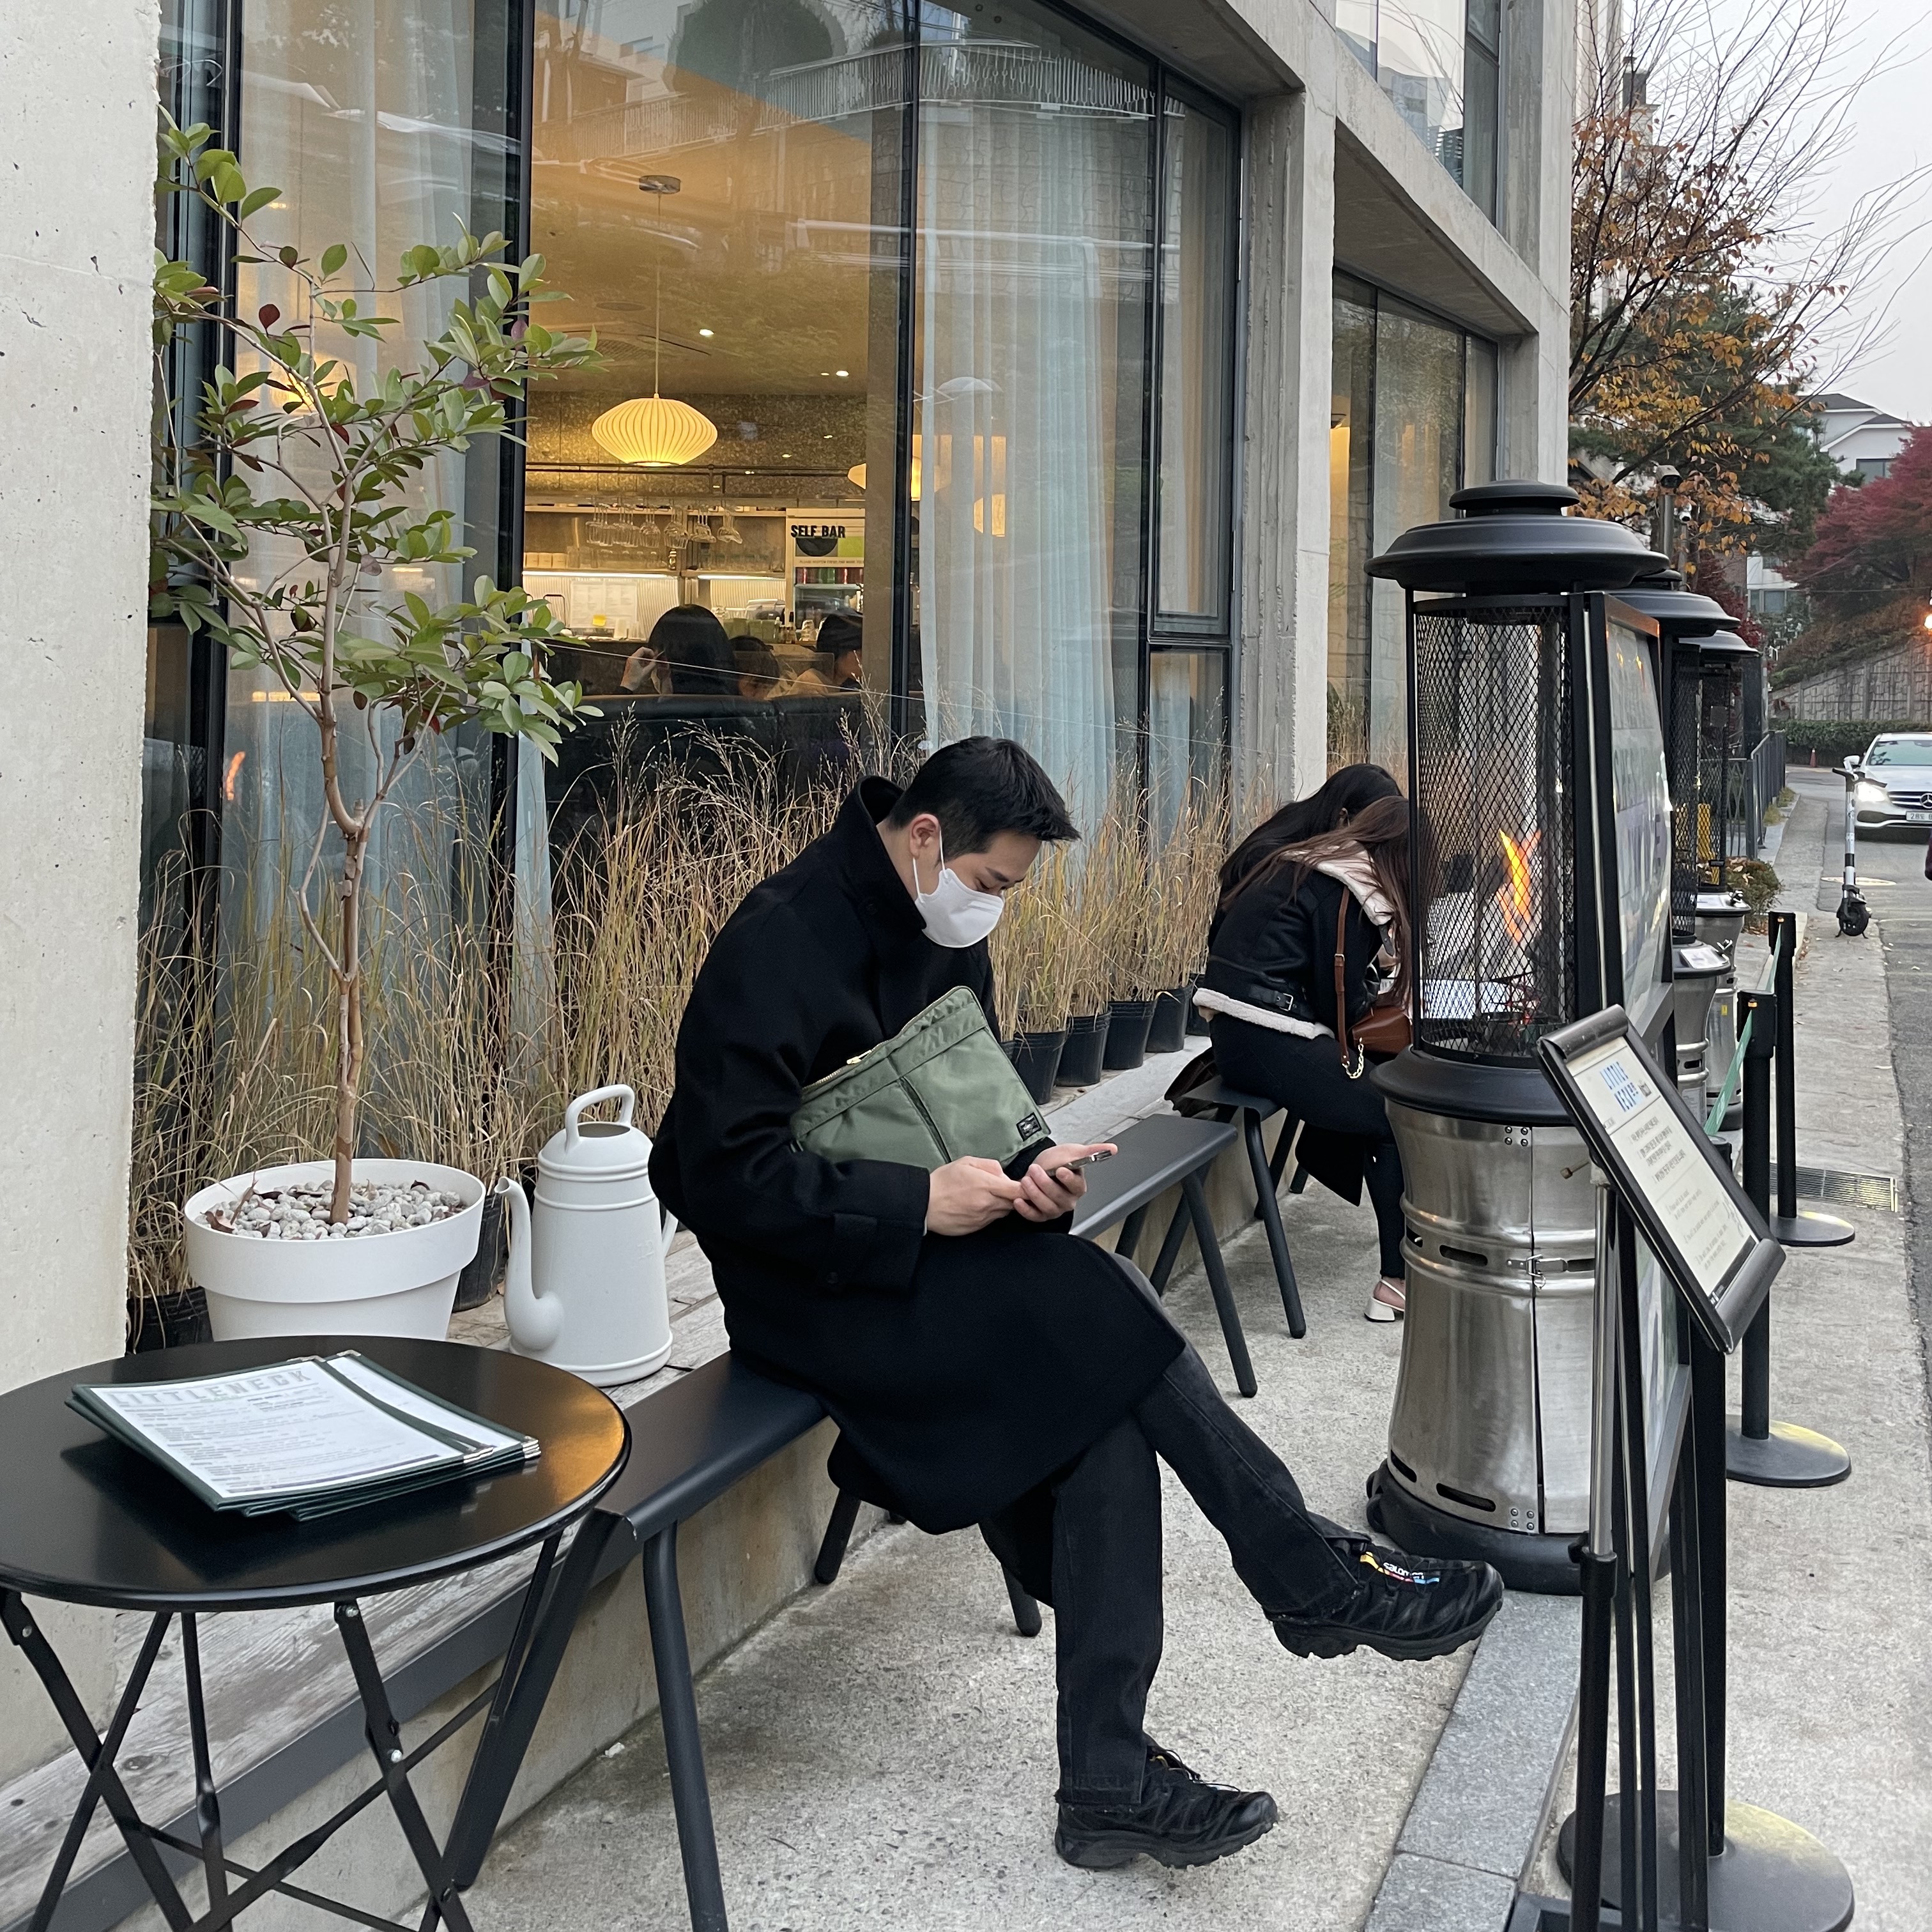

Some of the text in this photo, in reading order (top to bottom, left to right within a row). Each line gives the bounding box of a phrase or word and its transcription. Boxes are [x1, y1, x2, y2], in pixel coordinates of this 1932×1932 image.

[790, 525, 846, 538] SELF BAR
[1600, 1061, 1629, 1090] LITTLE
[107, 1370, 311, 1406] LITTLENECK
